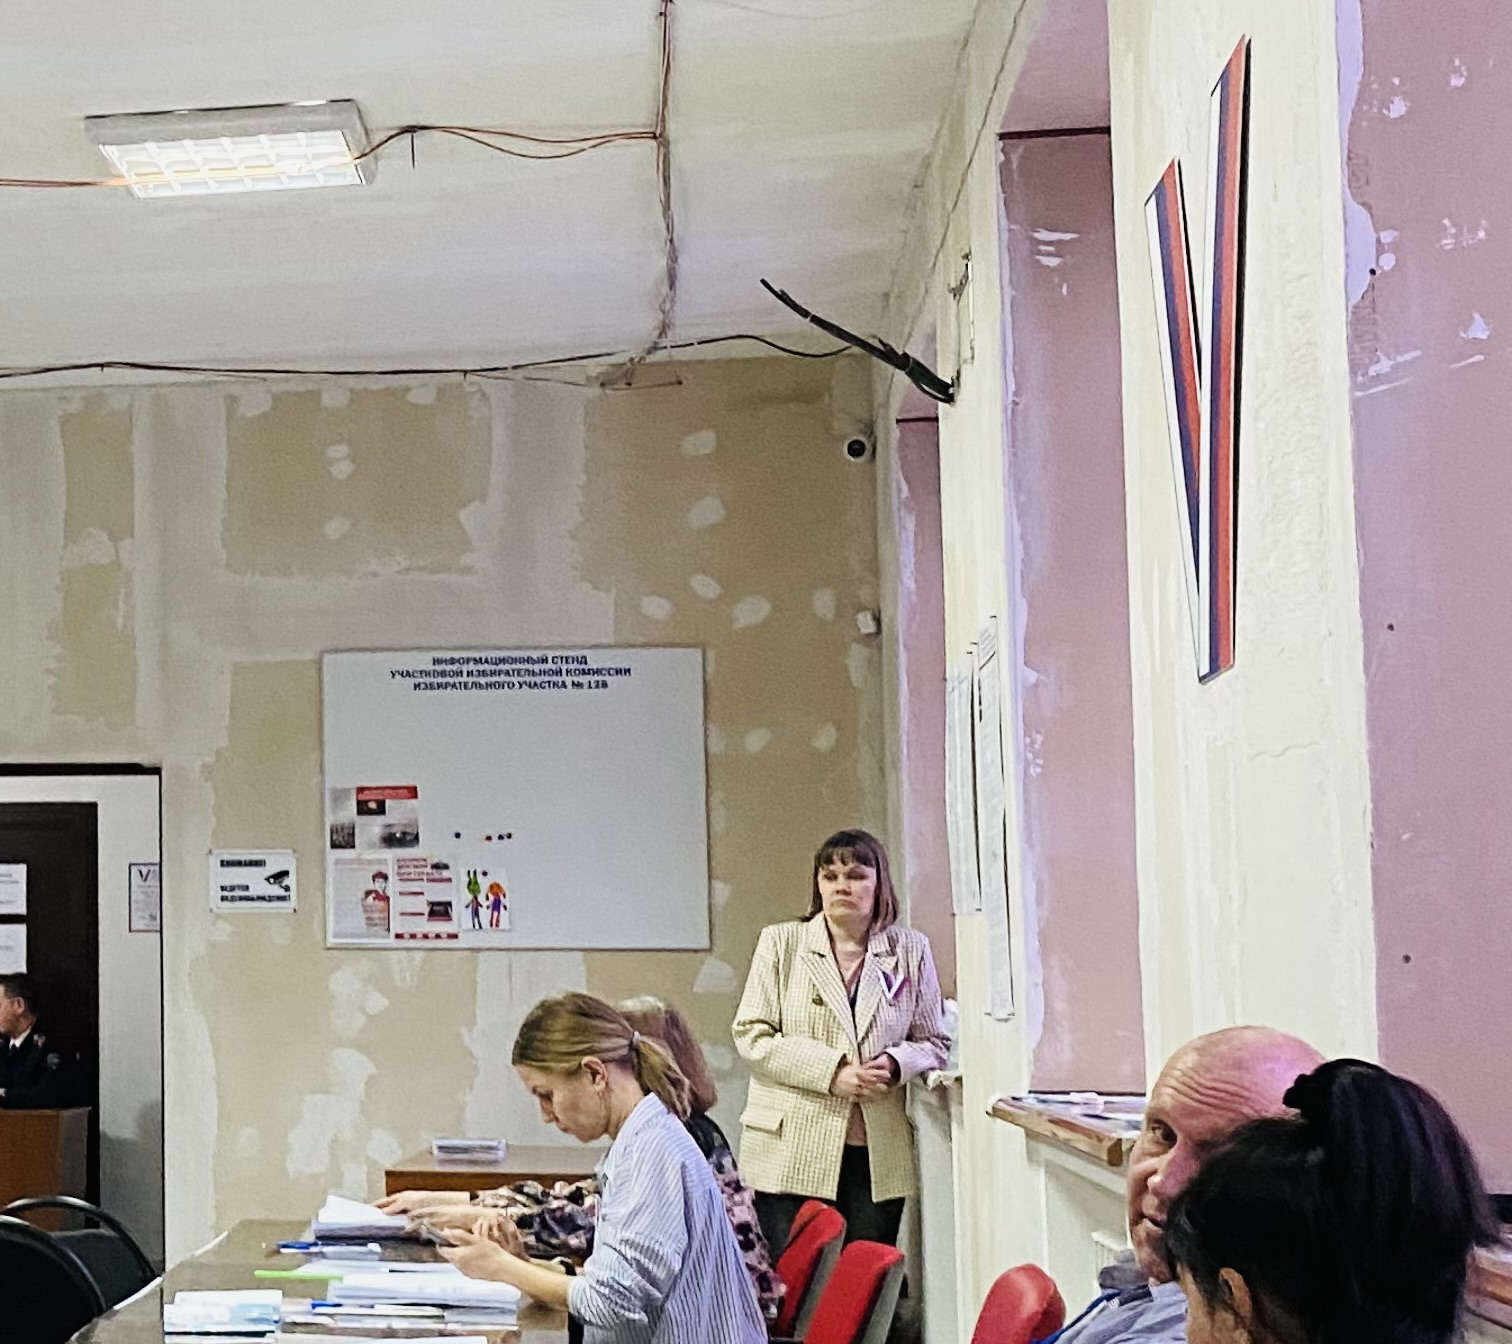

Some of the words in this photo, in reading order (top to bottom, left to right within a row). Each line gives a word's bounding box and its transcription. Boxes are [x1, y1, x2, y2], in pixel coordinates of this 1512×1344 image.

[432, 655, 548, 667] ИНФОРМАЦИОННЫЙ
[551, 655, 588, 666] СТЕНД
[390, 668, 463, 679] УЧАСТКОВОЙ
[466, 667, 563, 678] ИЗБИРАТЕЛЬНОЙ
[565, 666, 632, 677] КОМИССИИ
[413, 680, 515, 691] ИЗБИРАТЕЛЬНОГО
[516, 680, 568, 690] УЧАСТКА
